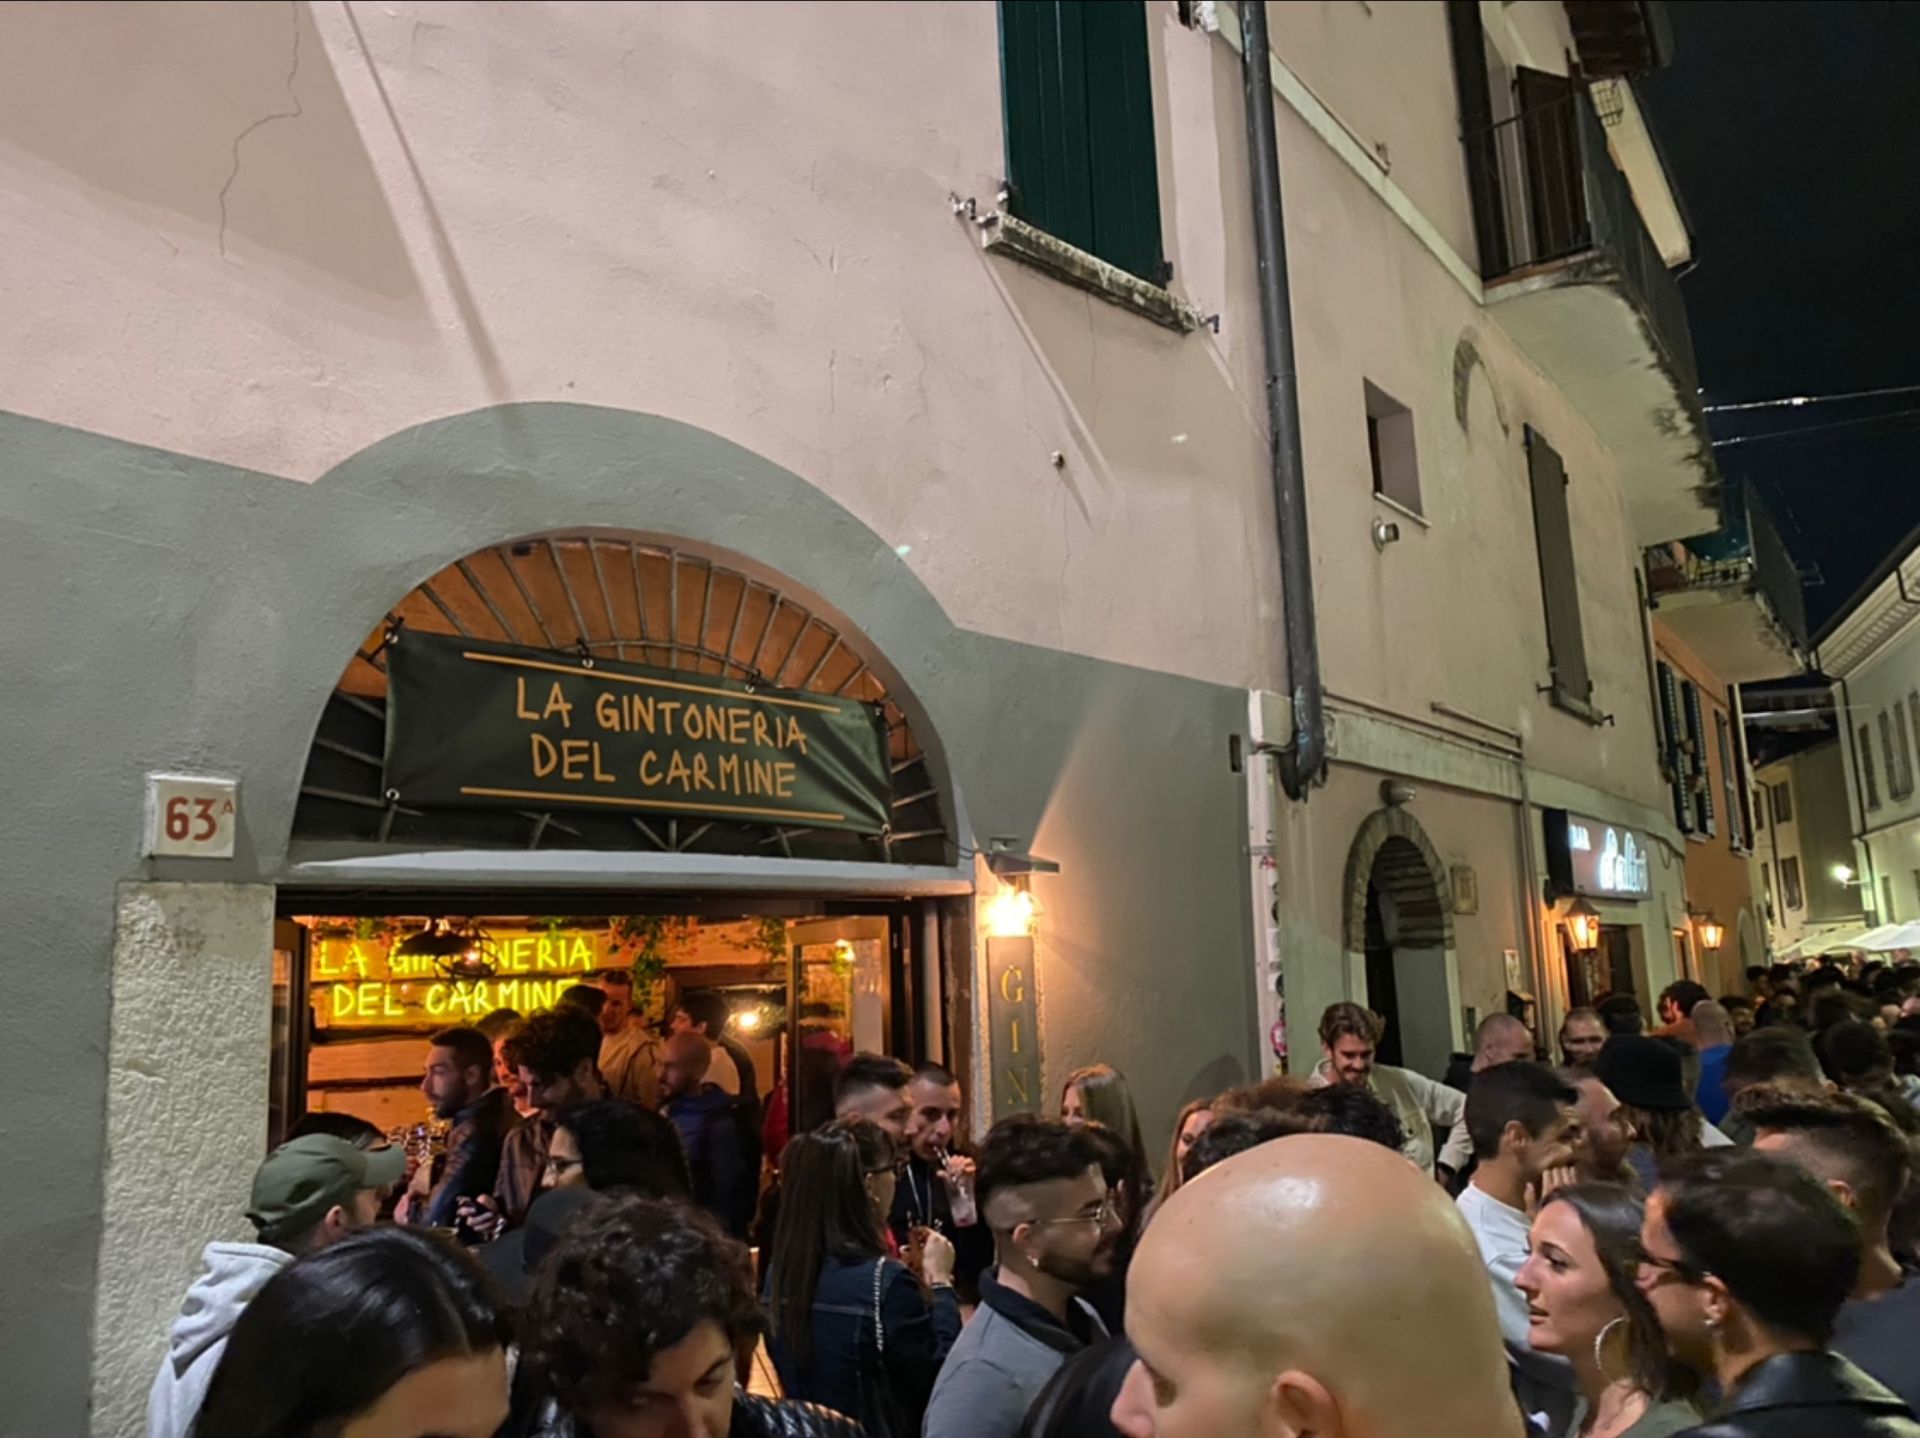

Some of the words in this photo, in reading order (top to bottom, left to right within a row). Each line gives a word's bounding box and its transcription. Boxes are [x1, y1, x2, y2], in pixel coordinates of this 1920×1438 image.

[517, 676, 573, 728] LA
[595, 692, 809, 755] GINTONERIA
[529, 732, 617, 784] DEL
[638, 750, 797, 799] CARMINE
[319, 939, 367, 976] LA
[388, 936, 593, 975] GINERIA
[332, 982, 404, 1017] DEL
[1001, 965, 1029, 1105] GIN
